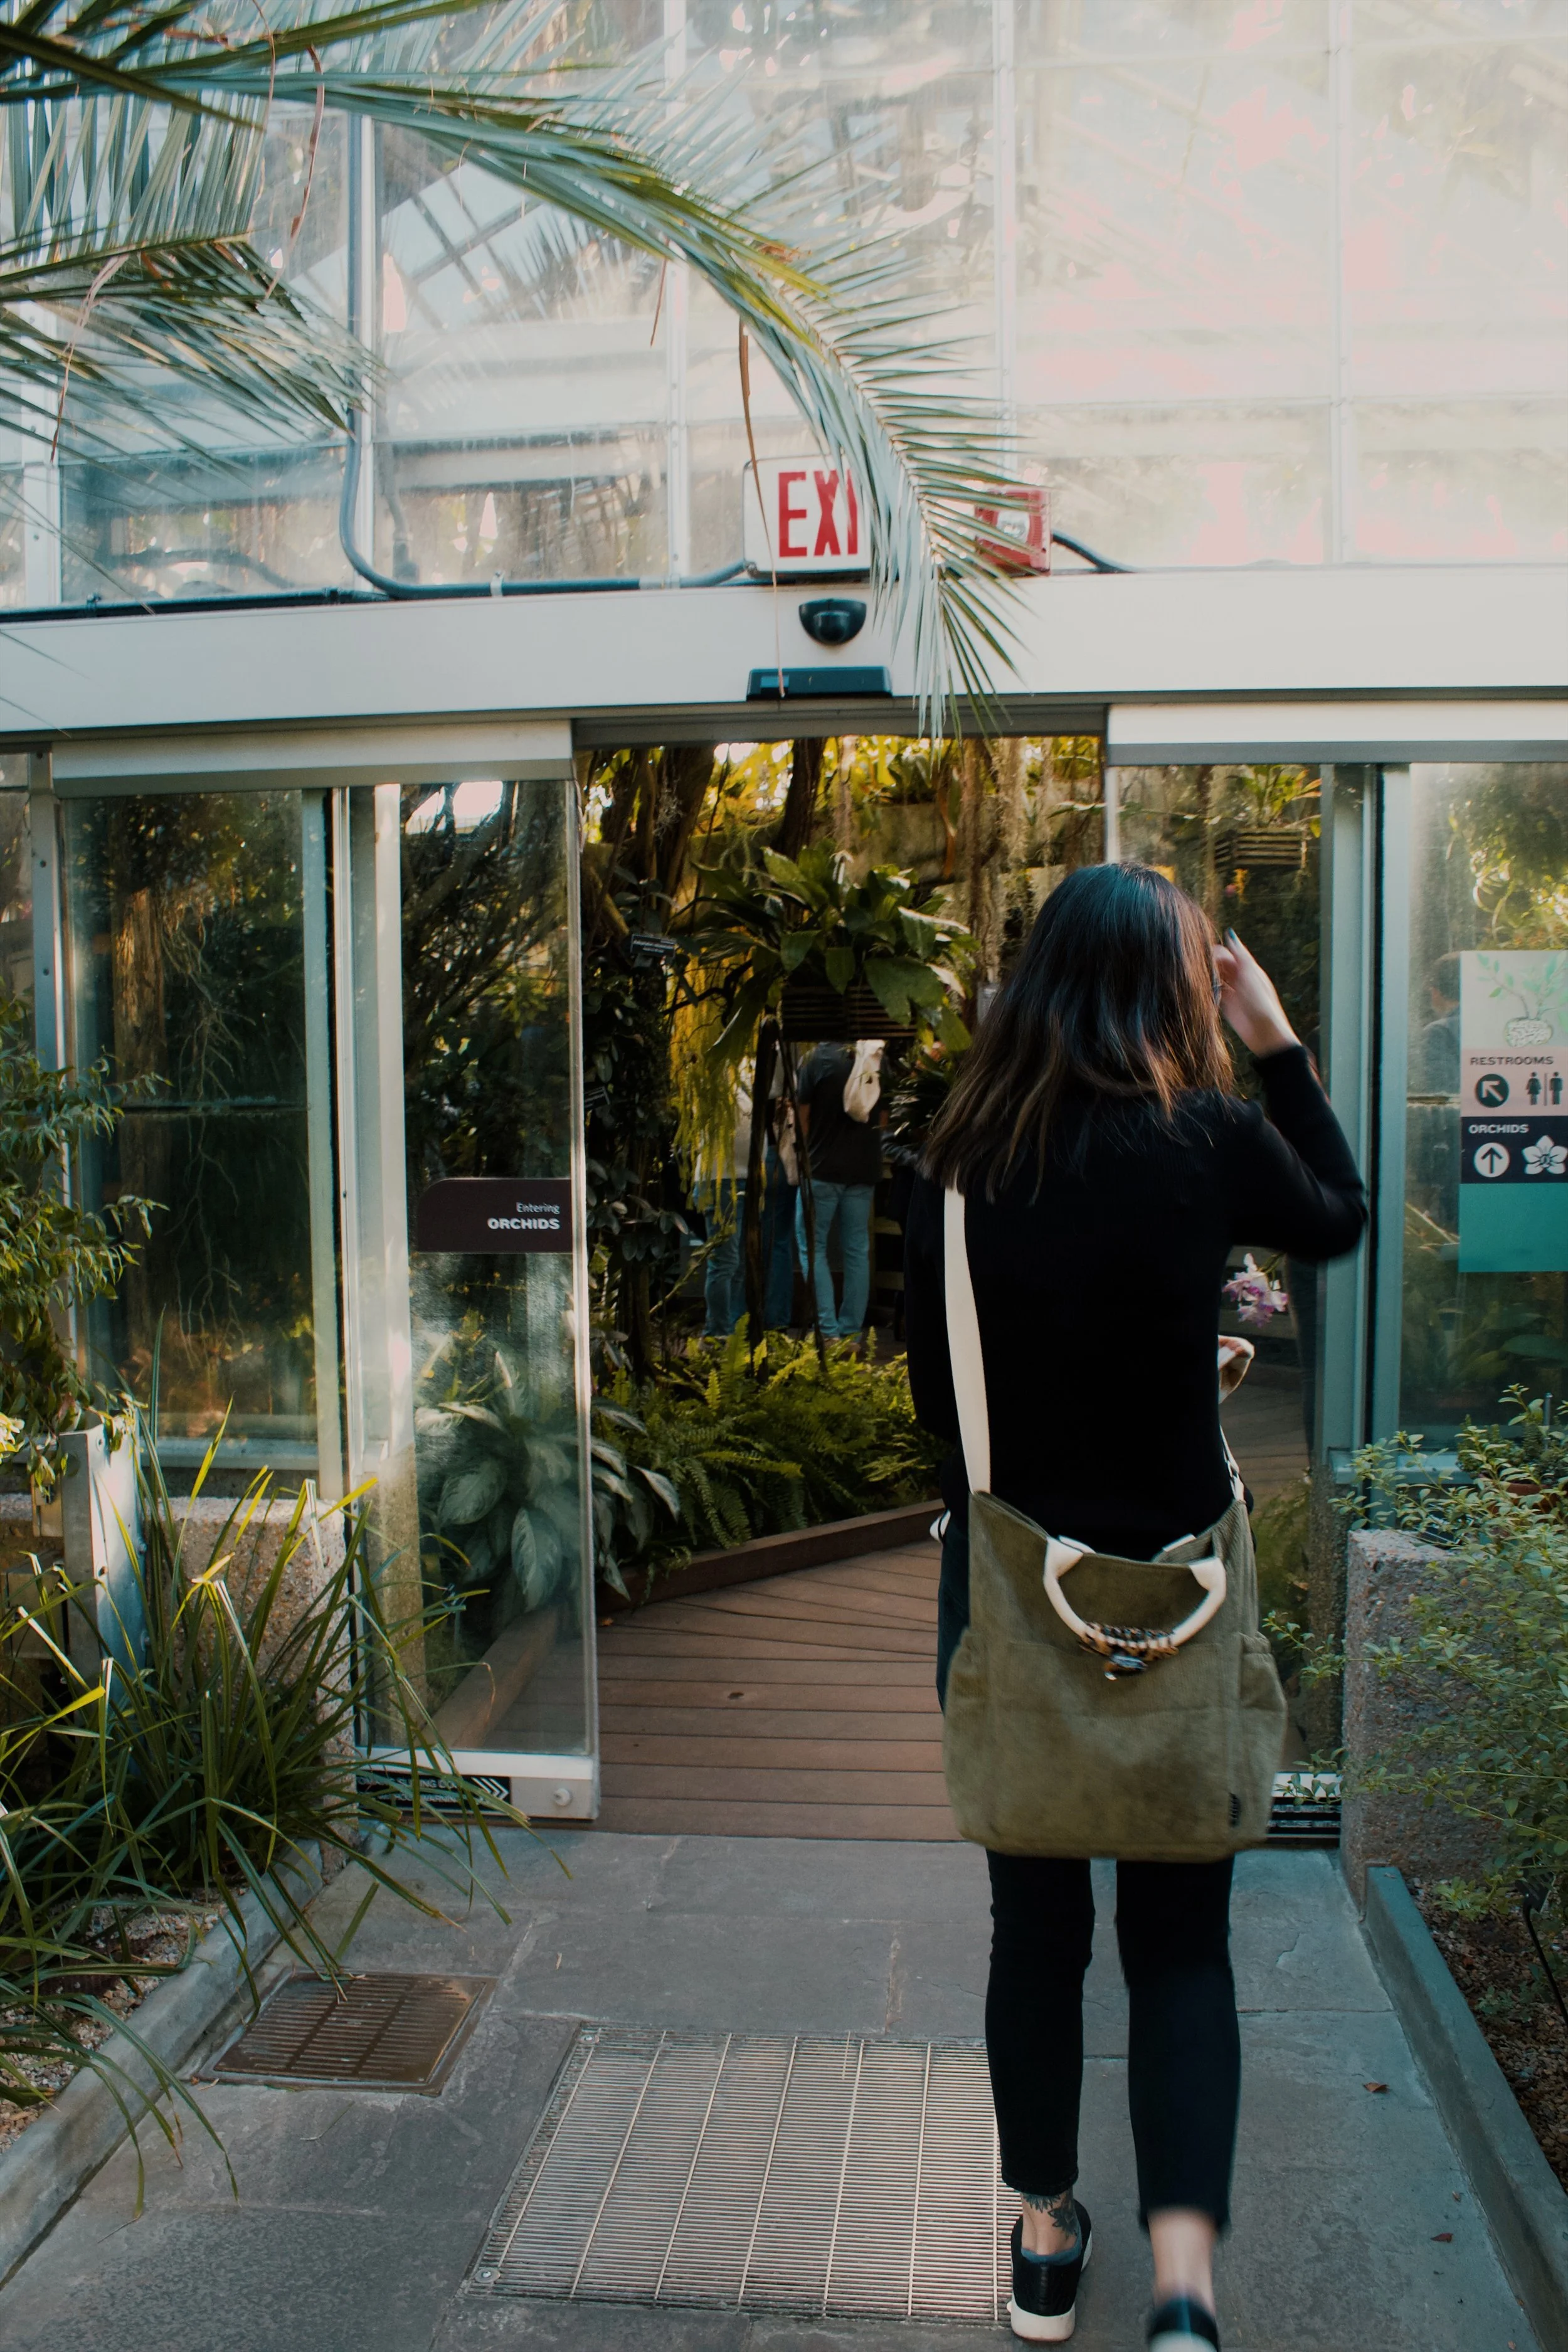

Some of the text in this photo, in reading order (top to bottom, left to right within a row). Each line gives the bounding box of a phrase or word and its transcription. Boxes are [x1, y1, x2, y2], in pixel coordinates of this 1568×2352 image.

[778, 469, 859, 558] EXI
[1470, 1056, 1554, 1065] RESTROOMS
[1468, 1124, 1530, 1133] ORCHIDS
[516, 1202, 560, 1214] Entering
[487, 1218, 560, 1229] ORCHIDS
